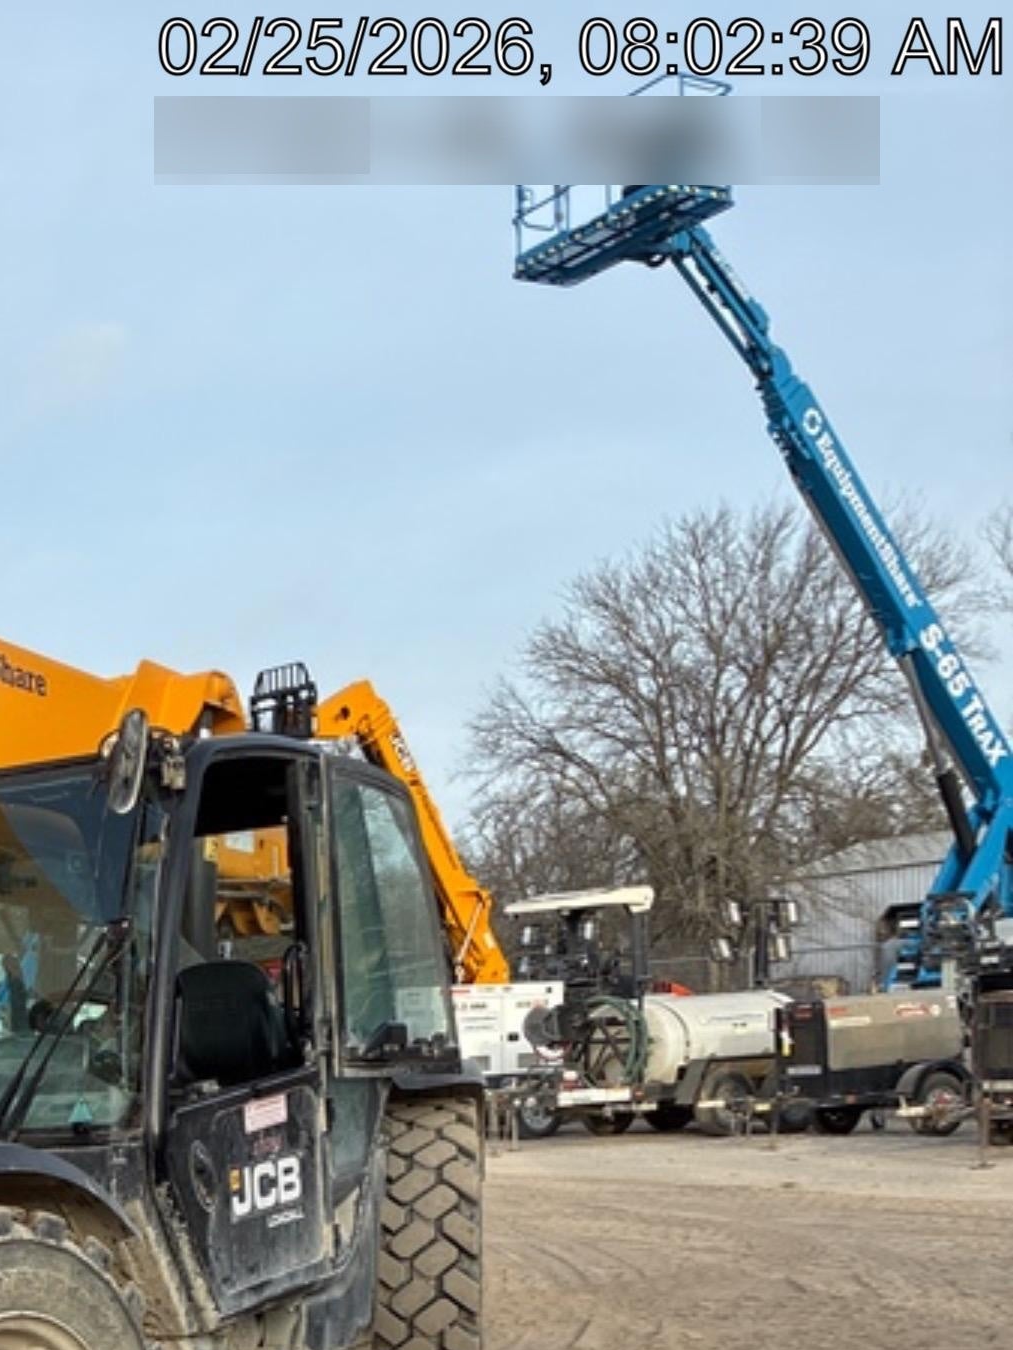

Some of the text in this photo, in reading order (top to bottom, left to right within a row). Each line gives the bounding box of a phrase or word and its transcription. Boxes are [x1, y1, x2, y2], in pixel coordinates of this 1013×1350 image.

[815, 431, 923, 608] EquipmentShare
[920, 623, 970, 698] S-65
[232, 1156, 301, 1215] JCB
